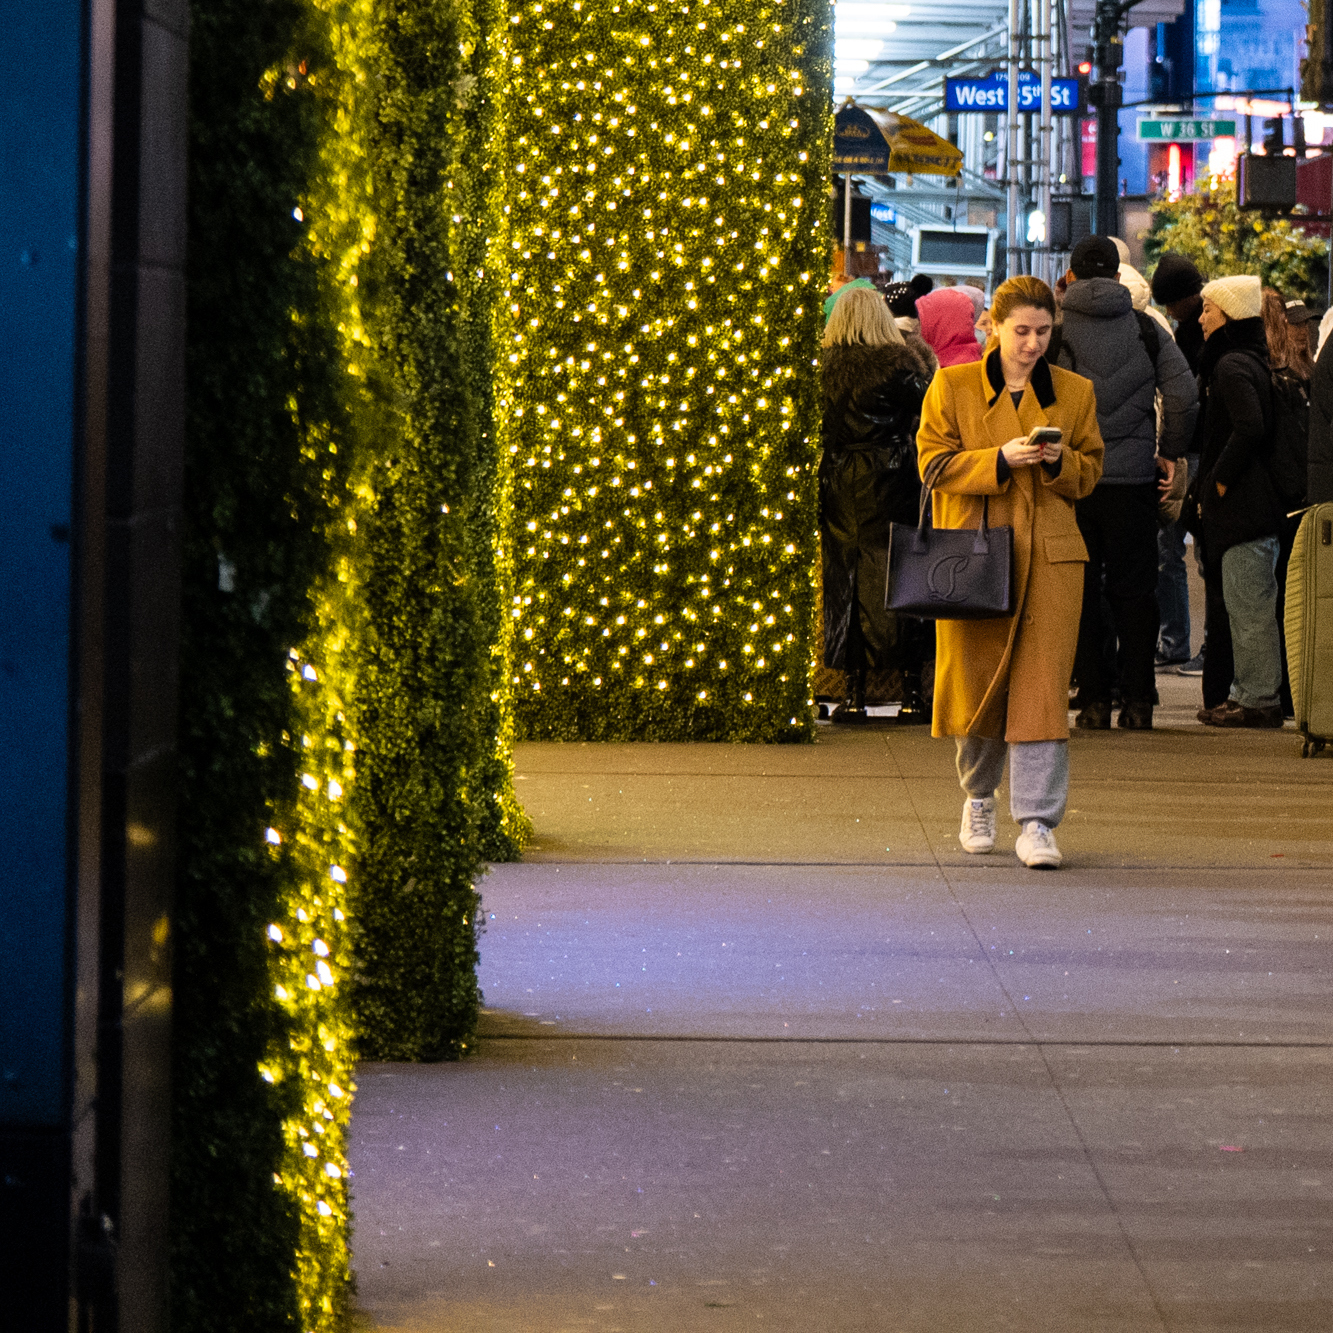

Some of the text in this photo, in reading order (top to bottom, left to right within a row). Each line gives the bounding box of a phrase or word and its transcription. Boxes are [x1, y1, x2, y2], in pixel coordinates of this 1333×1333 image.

[955, 84, 1070, 106] West 5th St
[1160, 122, 1215, 137] W 36 St
